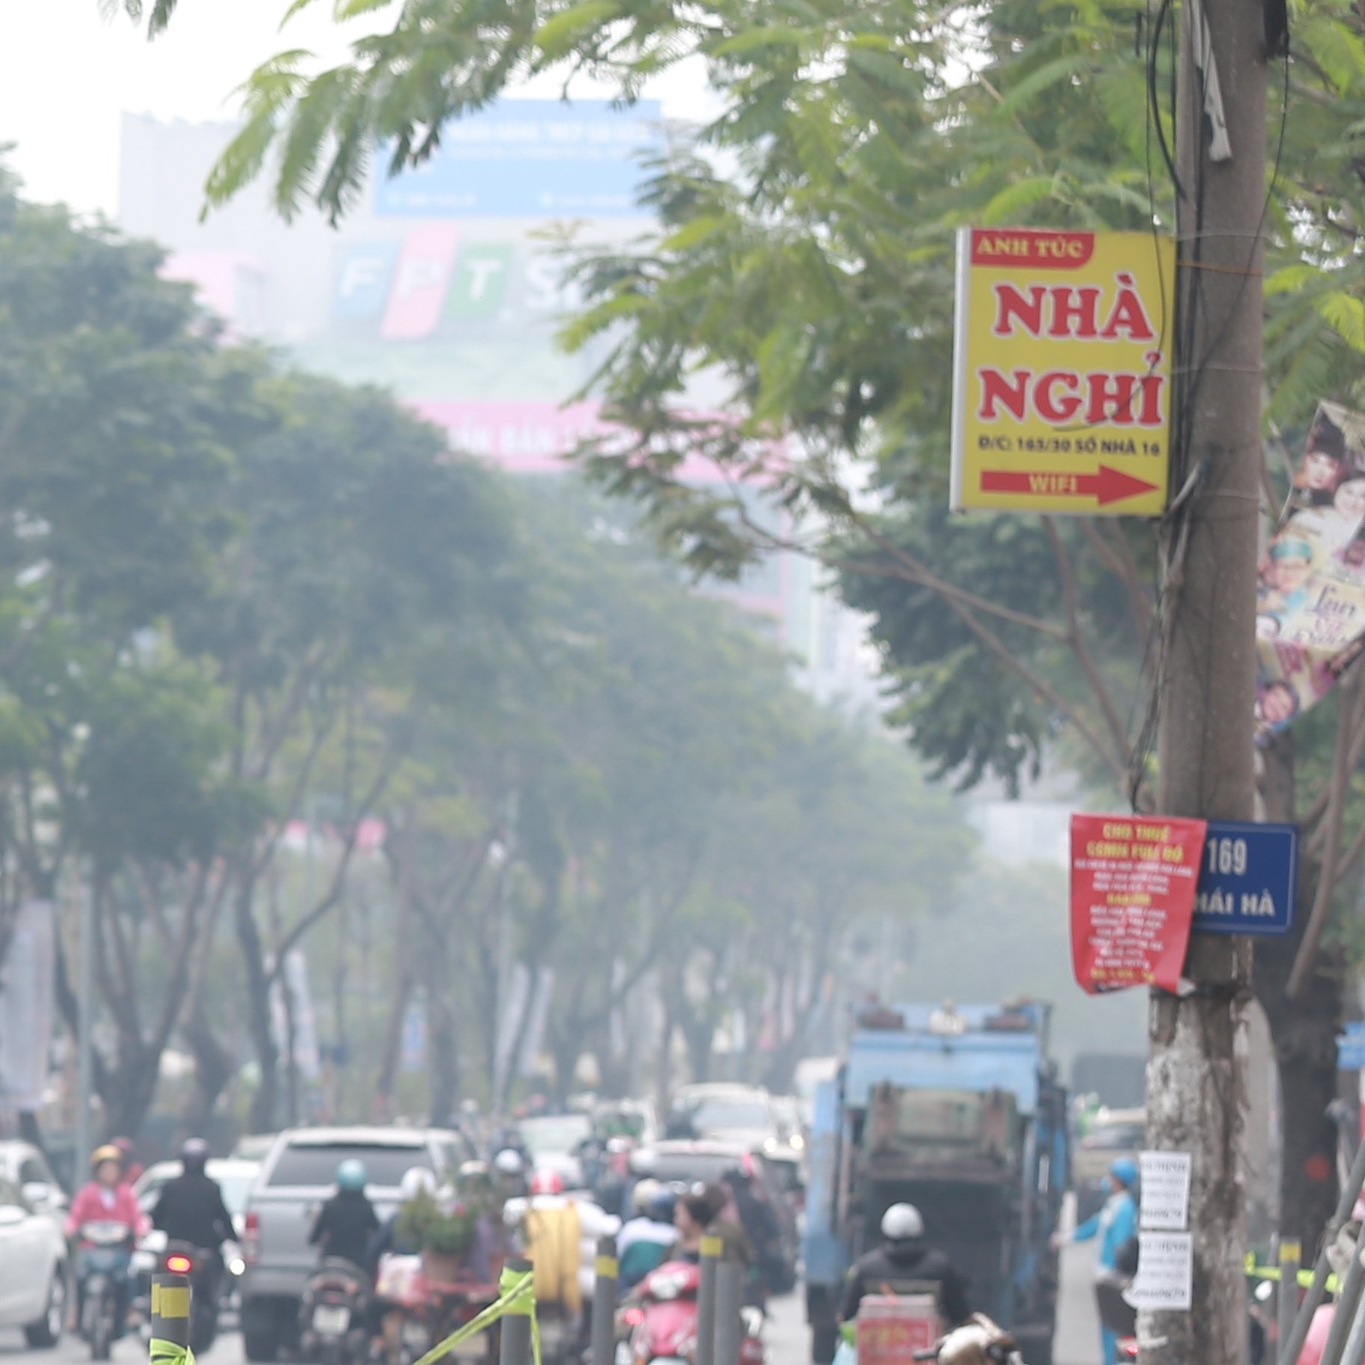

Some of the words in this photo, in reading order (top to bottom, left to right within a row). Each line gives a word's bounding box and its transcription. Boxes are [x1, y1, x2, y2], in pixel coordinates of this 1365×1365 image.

[977, 237, 1029, 256] ANH
[993, 272, 1155, 341] NHÀ
[977, 349, 1164, 428] NGHỈ
[1101, 436, 1137, 456] NHÀ
[1028, 473, 1078, 492] WIFI
[1208, 838, 1247, 875] 169
[1195, 886, 1234, 915] HÁI
[1240, 888, 1276, 917] HÀ
